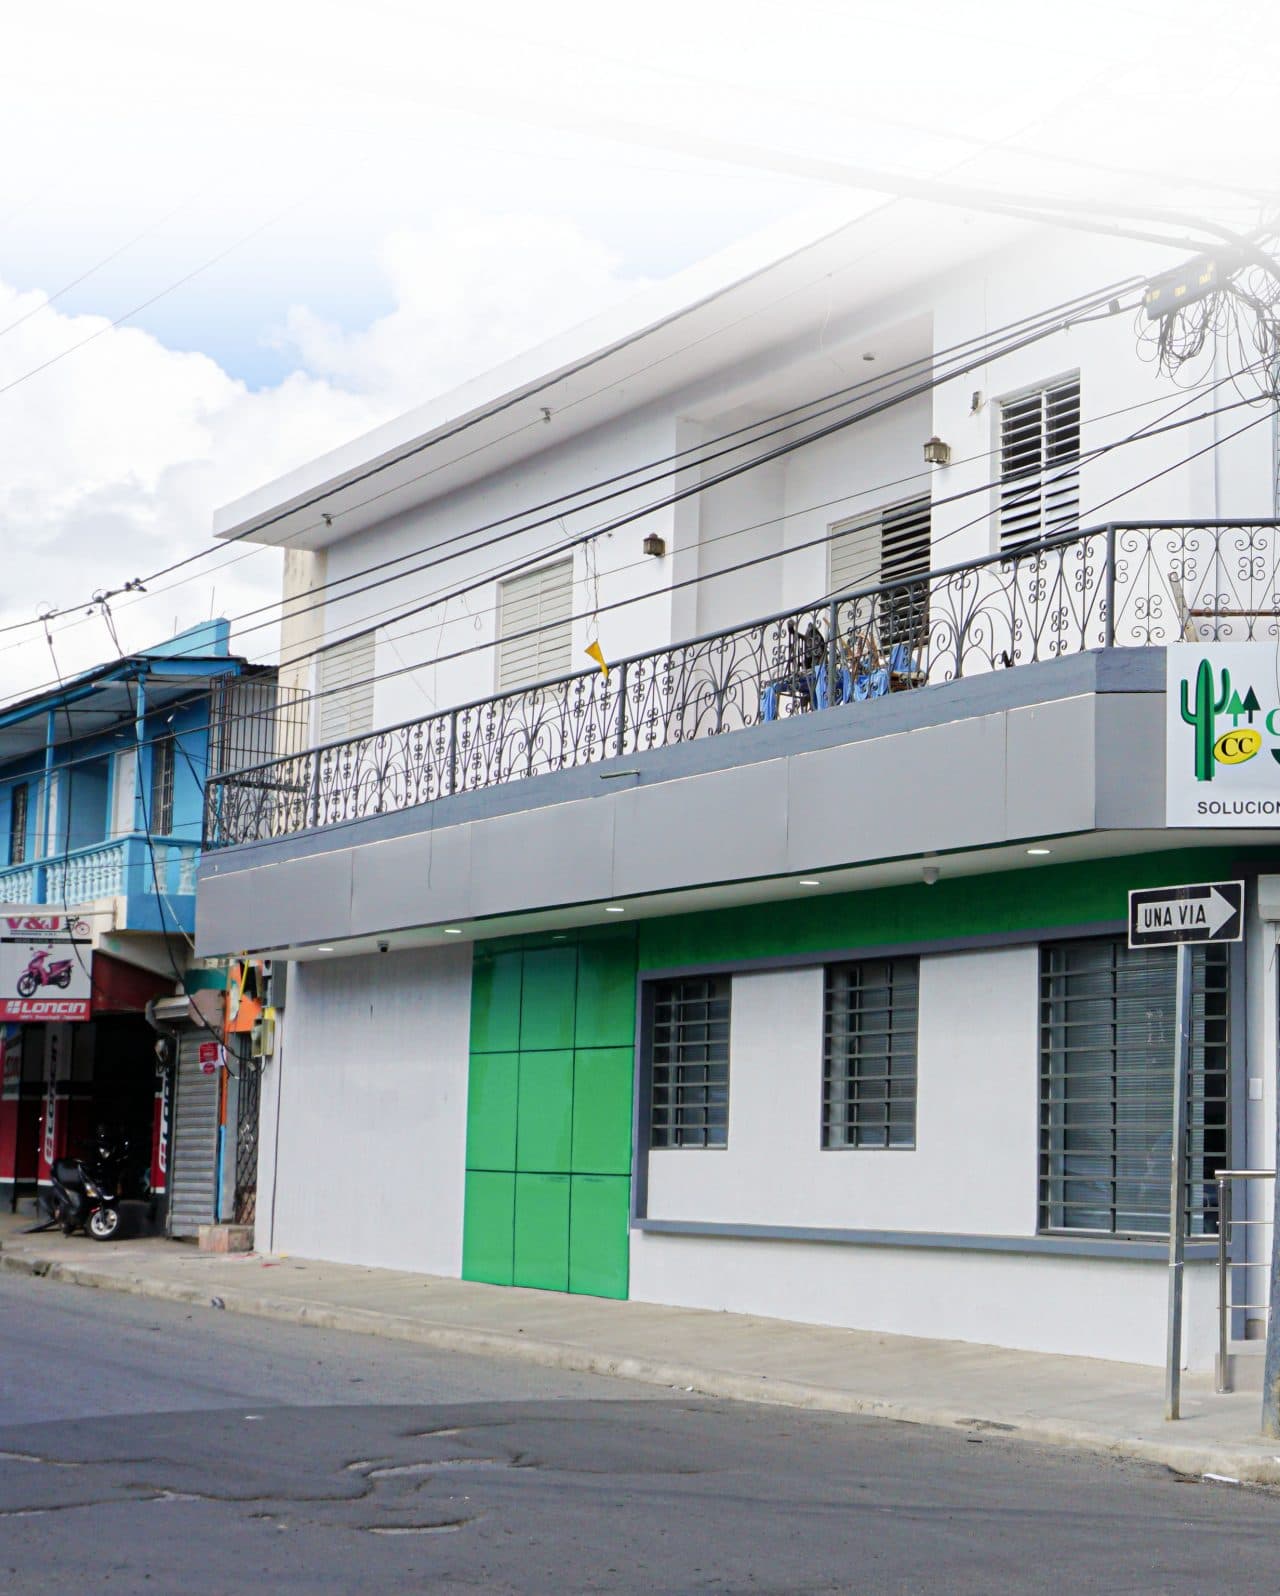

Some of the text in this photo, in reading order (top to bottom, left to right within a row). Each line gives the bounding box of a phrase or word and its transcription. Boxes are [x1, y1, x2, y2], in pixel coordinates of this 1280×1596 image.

[1221, 737, 1254, 757] CC
[1144, 903, 1207, 929] UNA VIA
